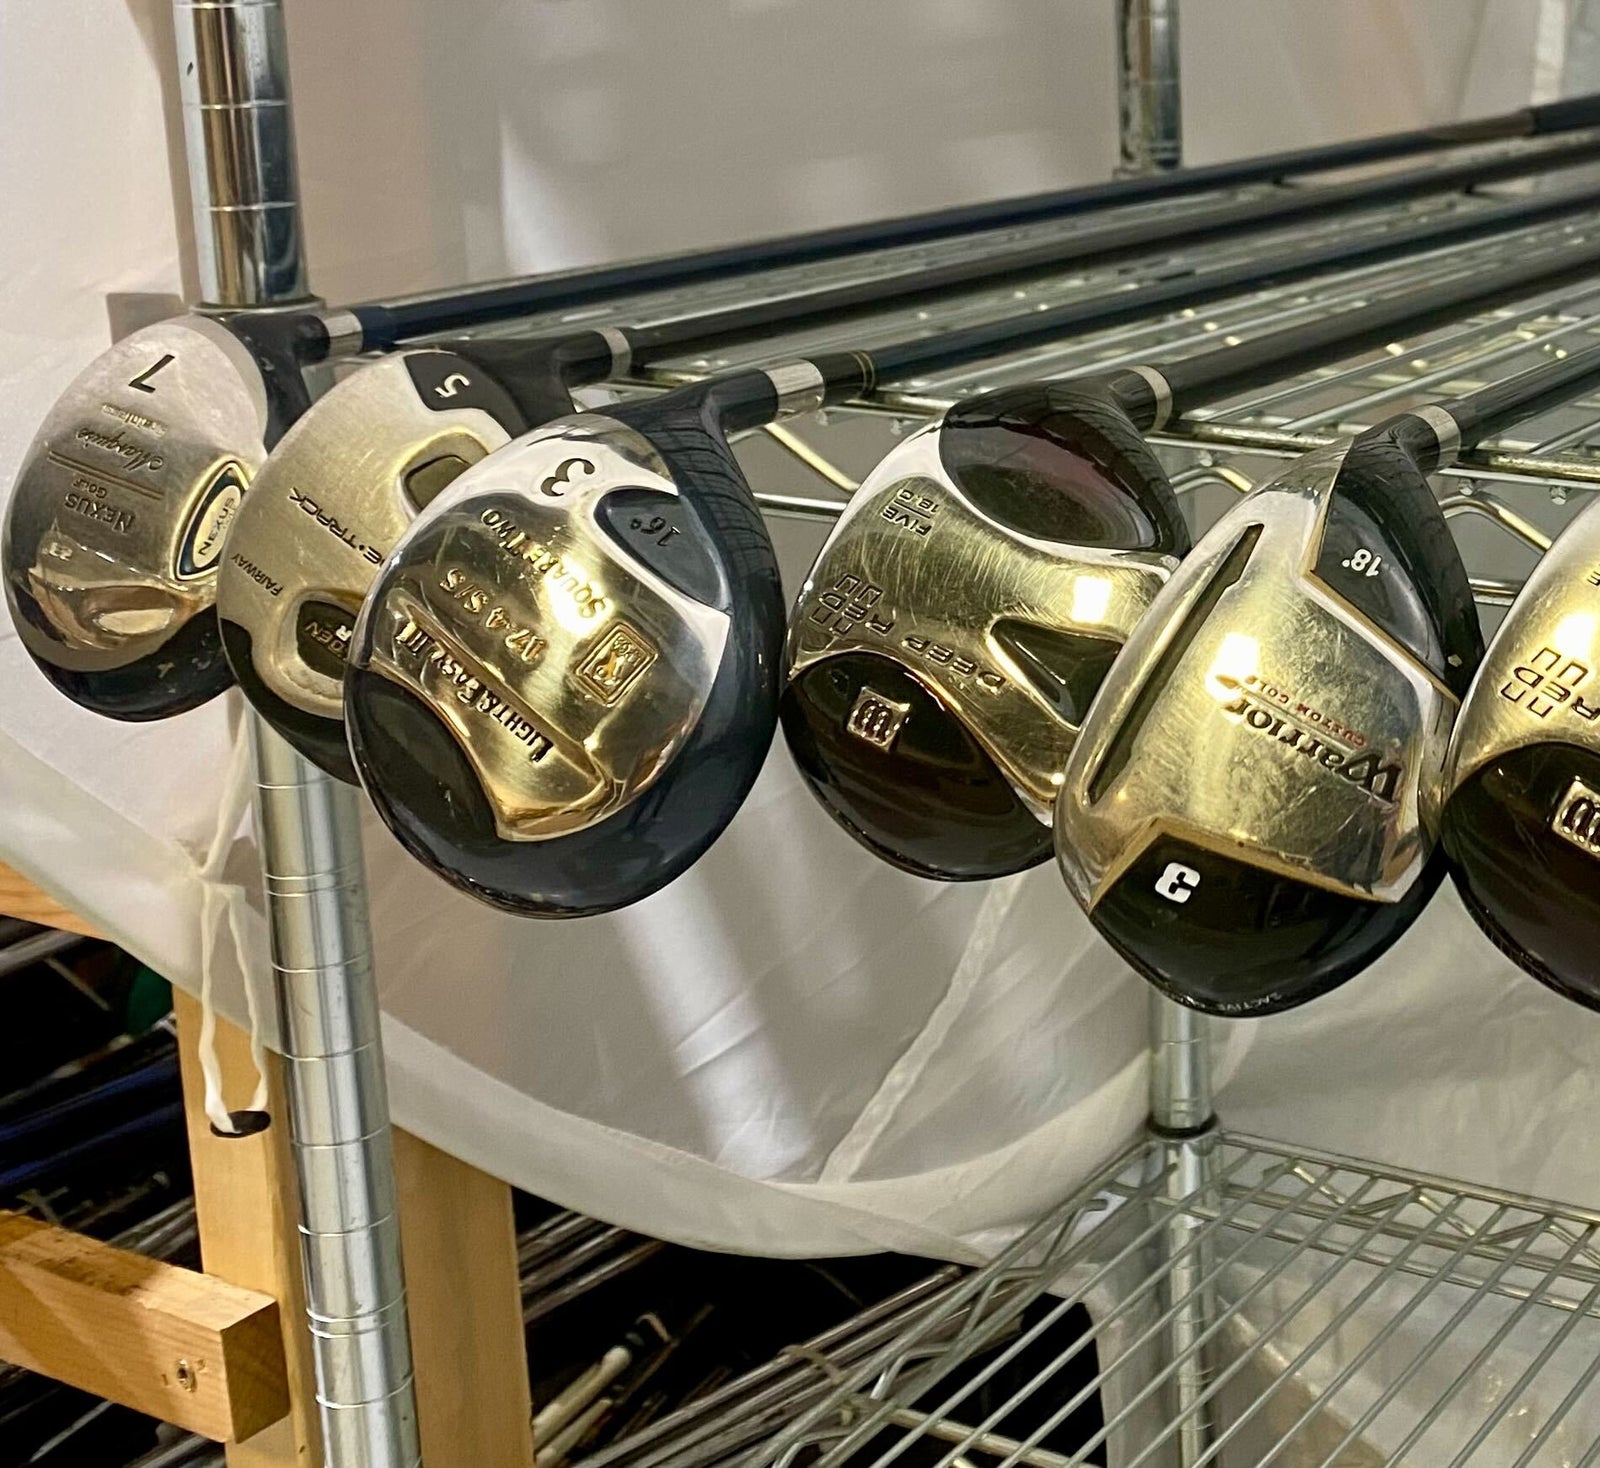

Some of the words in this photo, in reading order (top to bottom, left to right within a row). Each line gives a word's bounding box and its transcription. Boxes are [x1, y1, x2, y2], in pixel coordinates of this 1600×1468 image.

[128, 353, 176, 393] 7
[434, 373, 471, 398] 5
[540, 457, 596, 497] 3
[64, 492, 136, 535] NEXUS
[880, 508, 933, 536] FIVE
[229, 553, 286, 597] FAIRWAY
[819, 591, 894, 636] RED
[902, 635, 1007, 693] DEEP
[1294, 702, 1366, 748] CUSTOM
[1223, 697, 1402, 802] Warrior
[1155, 861, 1200, 903] 3
